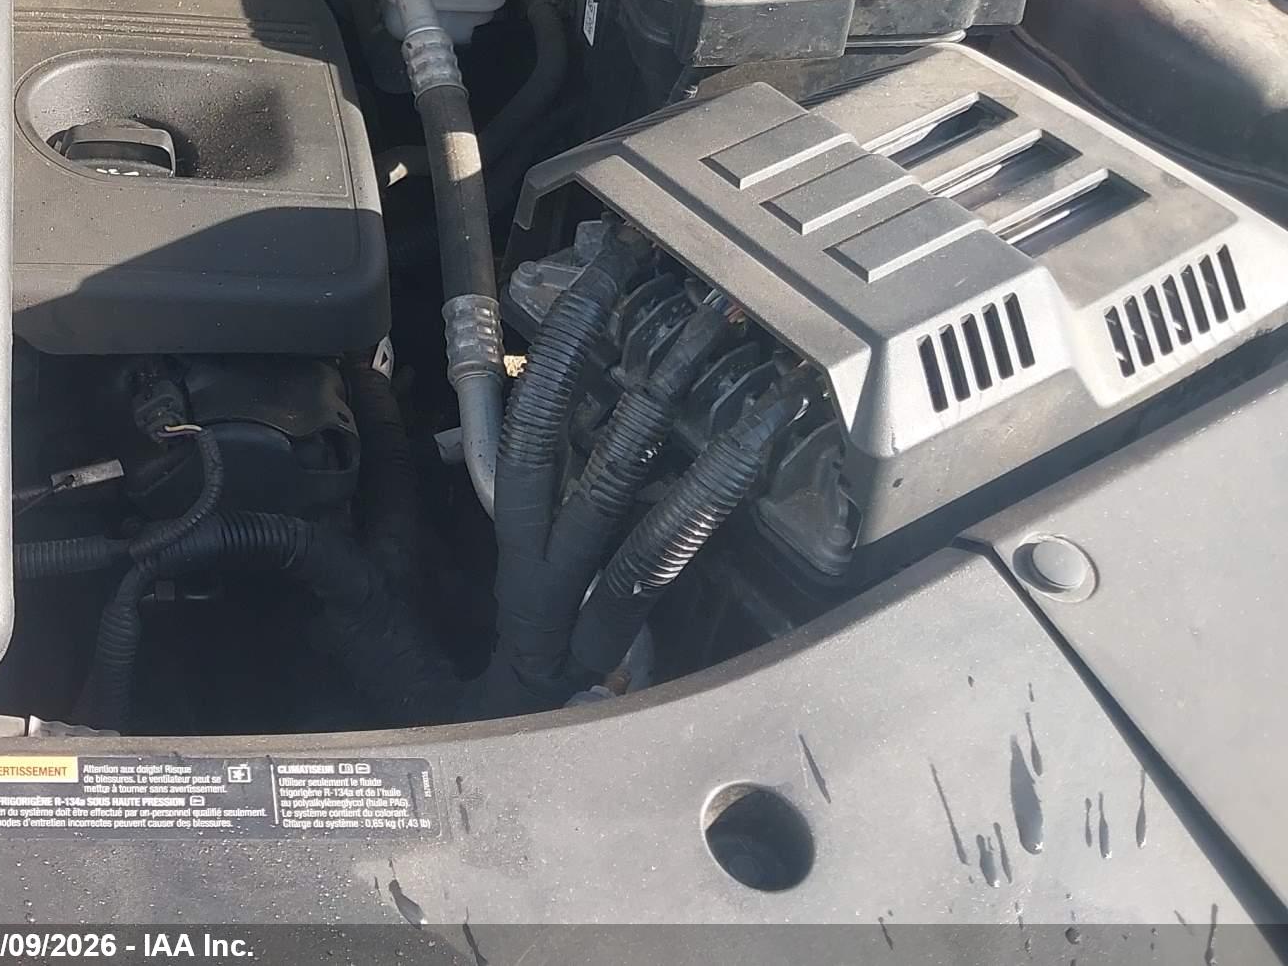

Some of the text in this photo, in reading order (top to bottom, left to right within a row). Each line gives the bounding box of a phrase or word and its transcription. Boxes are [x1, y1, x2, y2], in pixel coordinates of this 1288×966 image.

[83, 764, 119, 774] Attention
[120, 766, 135, 774] aux
[164, 765, 192, 775] Risque
[277, 765, 335, 774] CLIMATISEUR
[83, 775, 94, 783] de
[96, 775, 136, 783] blessures.
[137, 775, 147, 783] Le
[149, 775, 191, 783] ventilateur
[192, 775, 210, 785] peut
[279, 778, 382, 787] Utiliser seulement le fluide
[83, 785, 110, 793] mettre
[118, 785, 148, 793] tourner
[169, 785, 228, 794] avertissement.
[279, 788, 402, 798] frigorigène R-134a et de l'huile
[54, 797, 86, 806] R-134a
[87, 797, 111, 806] SOUS
[112, 797, 141, 806] HAUTE
[142, 797, 185, 806] PRESSION
[293, 798, 364, 809] polyalkylèneglycol
[366, 798, 388, 809] (huile
[7, 808, 18, 816] du
[20, 808, 54, 818] système
[72, 807, 88, 817] être
[90, 807, 122, 817] effectué
[124, 809, 138, 818] par
[192, 808, 222, 818] qualifié
[281, 809, 293, 817] Le
[293, 808, 327, 819] système
[328, 809, 361, 817] contient
[363, 809, 373, 817] du
[23, 818, 66, 827] d'entretien
[67, 818, 112, 827] incorrectes
[113, 819, 147, 829] peuvent
[147, 820, 175, 828] causer
[176, 819, 191, 828] des
[192, 819, 233, 828] blessures.
[282, 819, 311, 829] Charge
[313, 819, 324, 828] du
[325, 819, 359, 829] système
[385, 819, 396, 829] kg
[420, 819, 431, 829] lb)
